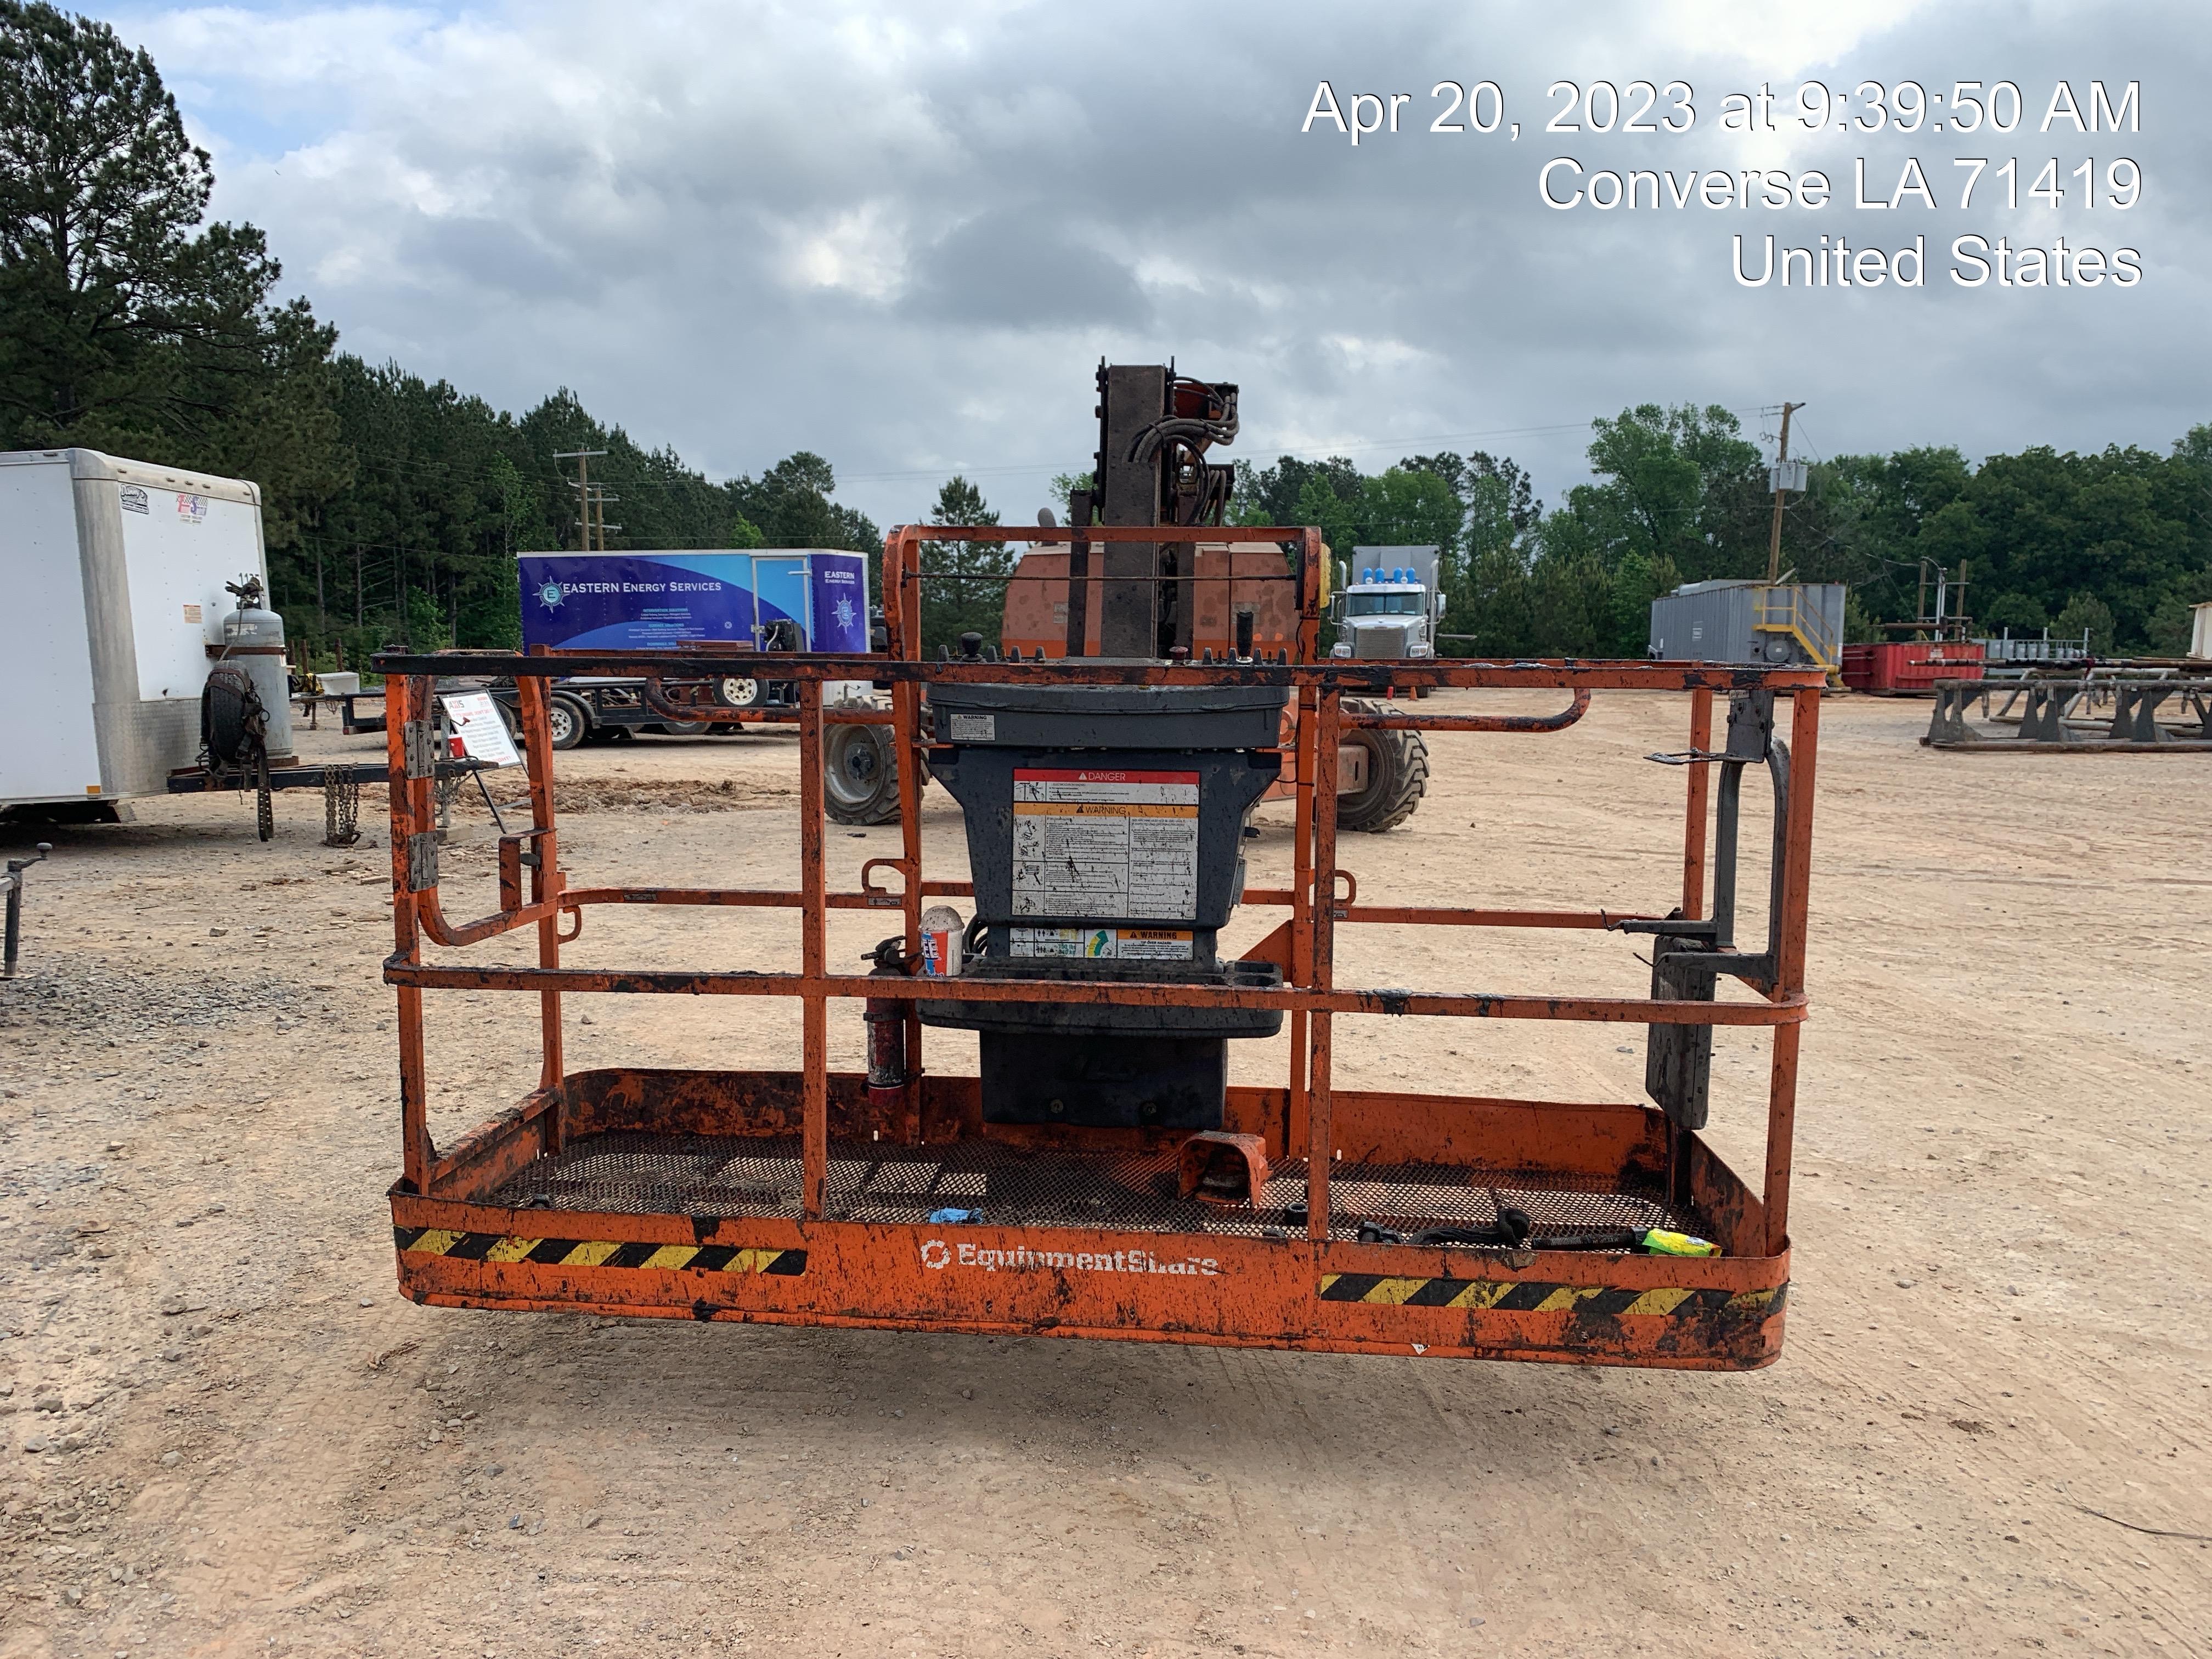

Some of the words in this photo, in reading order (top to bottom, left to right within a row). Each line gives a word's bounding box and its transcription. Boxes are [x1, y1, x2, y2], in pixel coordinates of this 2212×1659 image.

[825, 571, 855, 579] EASTERN
[563, 583, 619, 593] EASTERN
[623, 582, 666, 592] ENERGY
[669, 582, 721, 592] SERVICES
[449, 700, 465, 709] AXIS
[1088, 772, 1126, 781] DANGER
[1086, 806, 1126, 815] WARNING
[1141, 931, 1177, 939] WARNING
